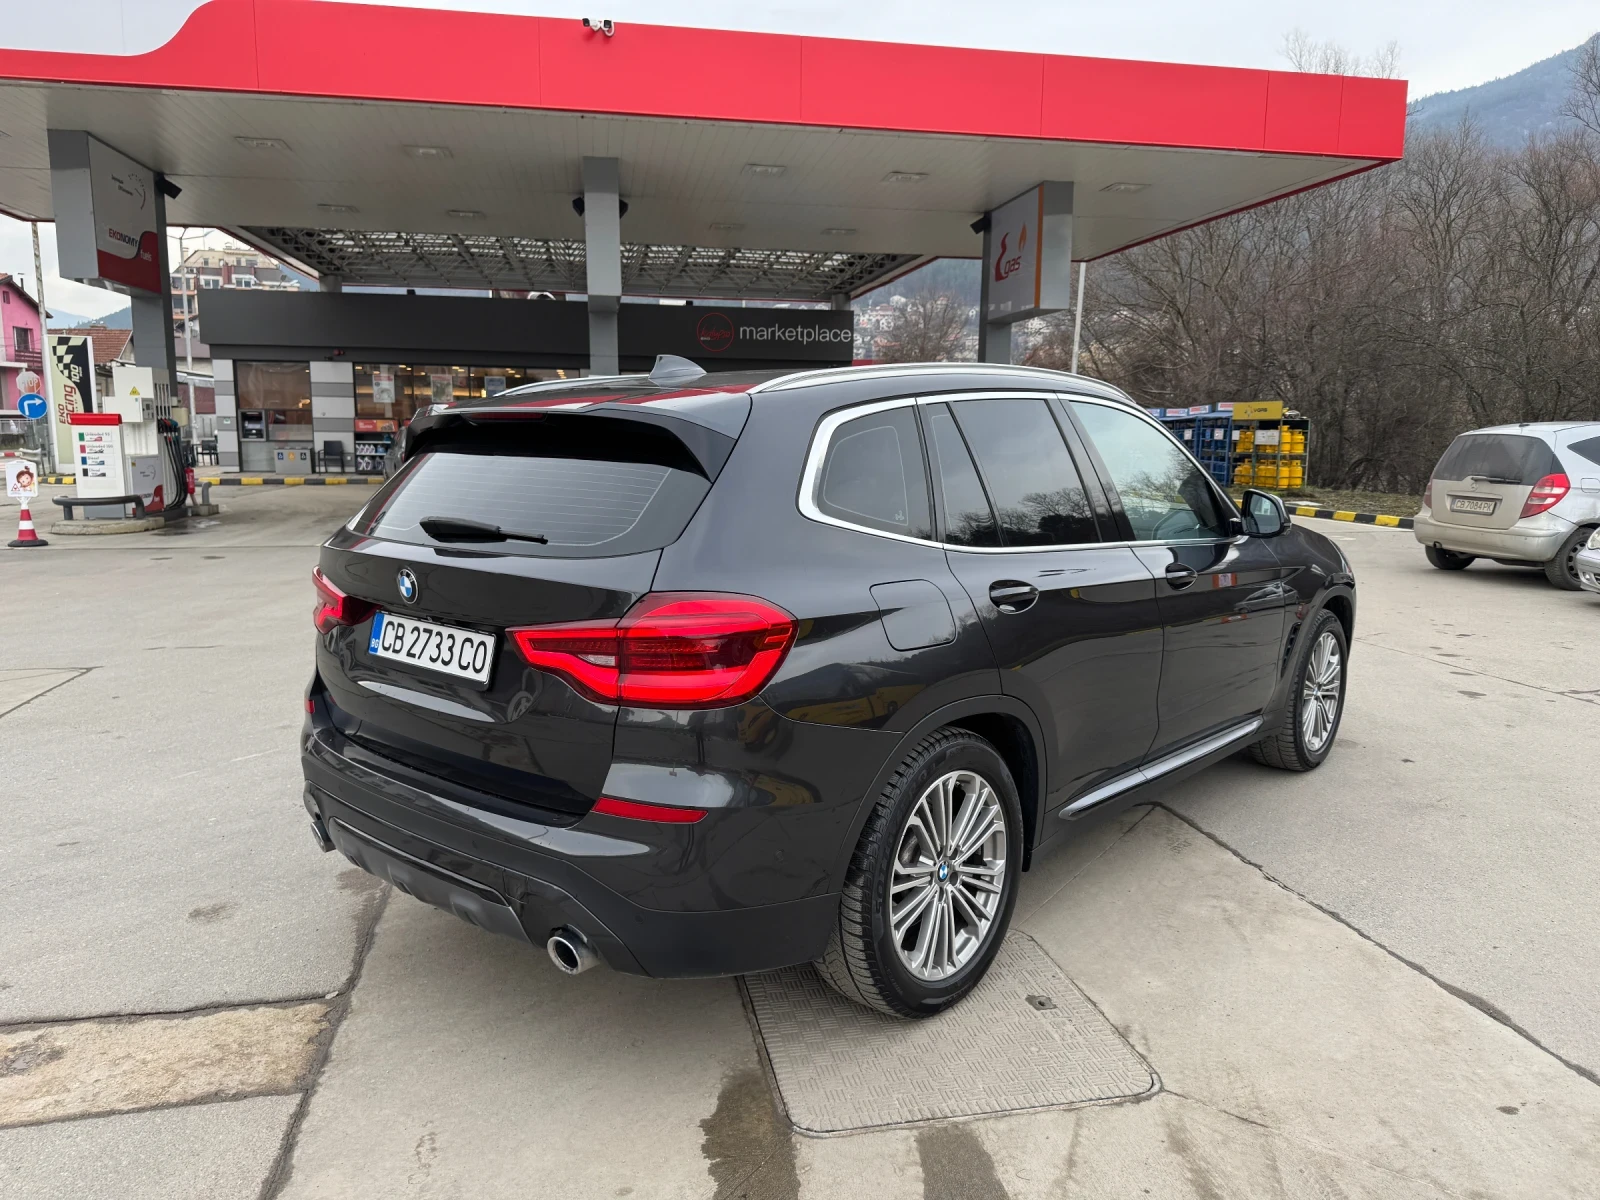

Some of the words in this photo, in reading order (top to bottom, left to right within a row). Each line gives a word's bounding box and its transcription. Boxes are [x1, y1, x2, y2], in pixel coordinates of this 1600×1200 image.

[109, 228, 139, 247] EKONOMY
[140, 249, 152, 261] fuels
[1004, 256, 1021, 278] gas
[740, 324, 852, 345] marketplace
[71, 364, 80, 382] 100
[58, 404, 66, 424] EKO
[371, 638, 379, 648] BG
[382, 620, 406, 654] CB
[406, 626, 455, 666] 2733
[458, 637, 487, 673] CO
